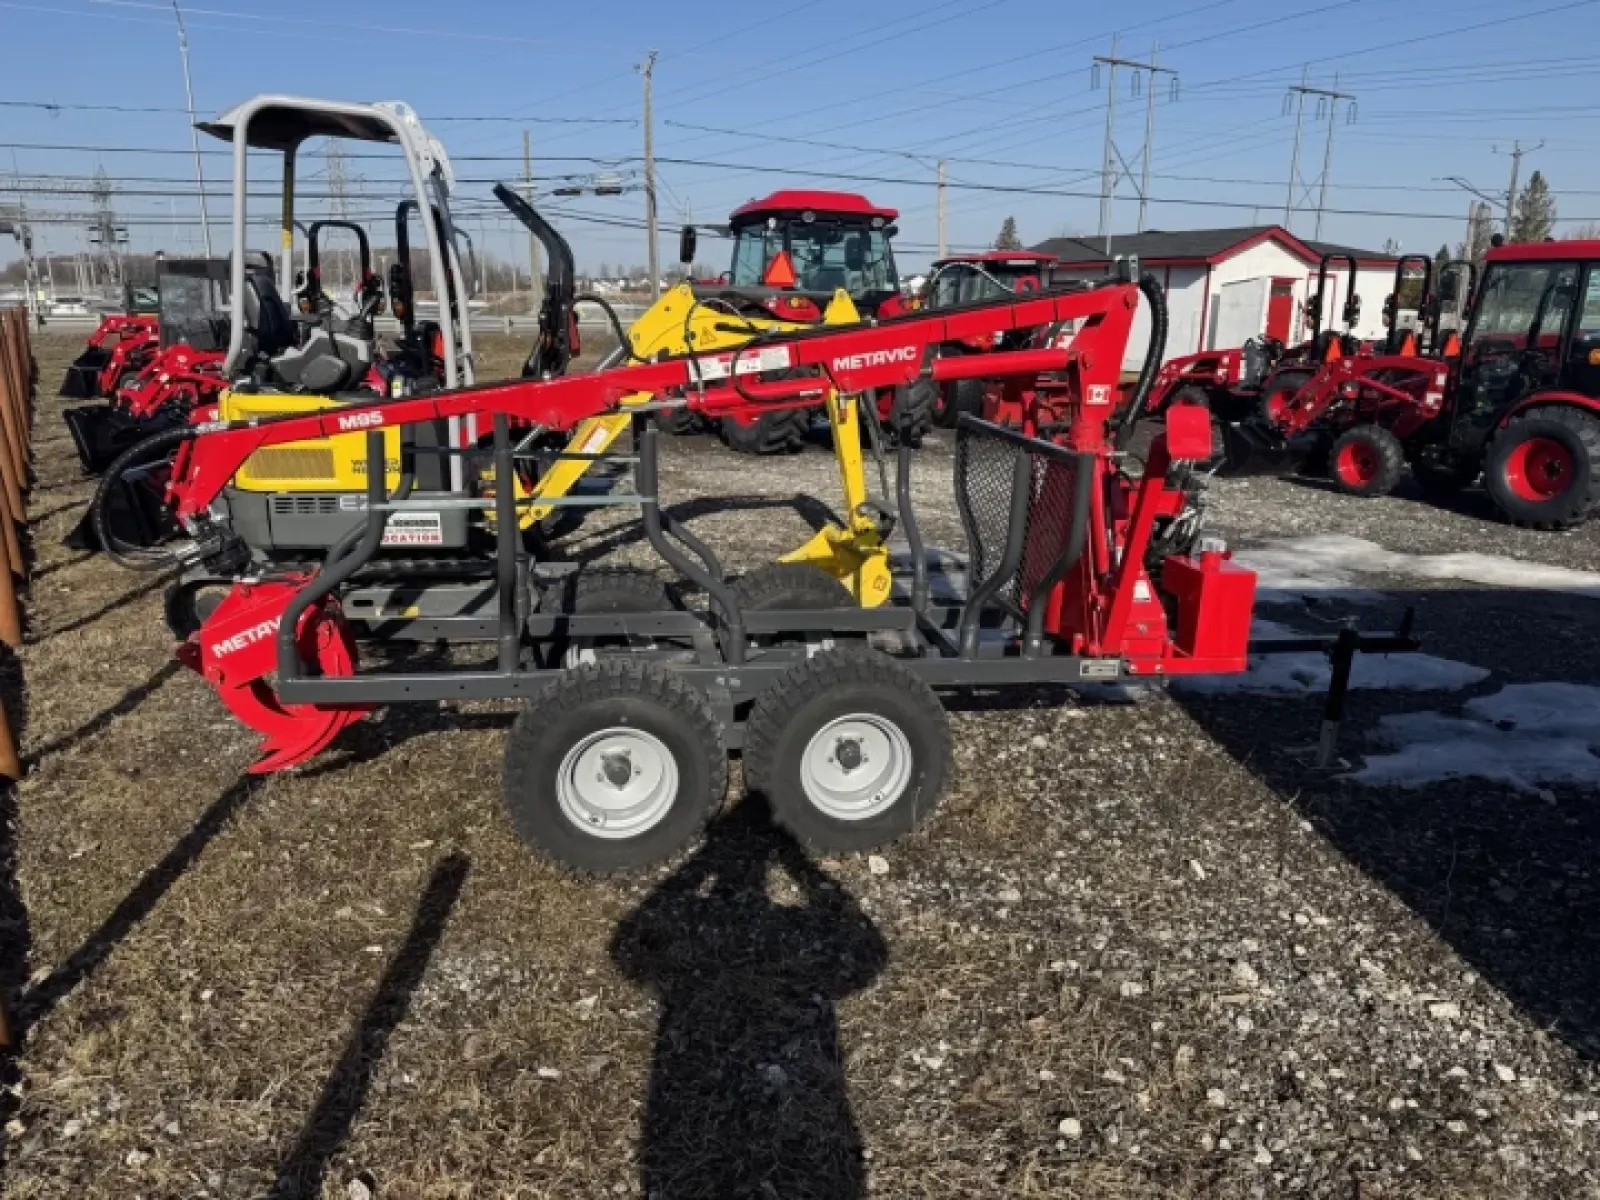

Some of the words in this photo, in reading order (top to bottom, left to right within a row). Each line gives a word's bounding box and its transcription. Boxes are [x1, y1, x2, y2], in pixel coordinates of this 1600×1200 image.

[832, 346, 917, 372] METAVIC
[337, 410, 383, 430] M95
[382, 533, 440, 543] OCATION
[211, 613, 284, 659] METAV
